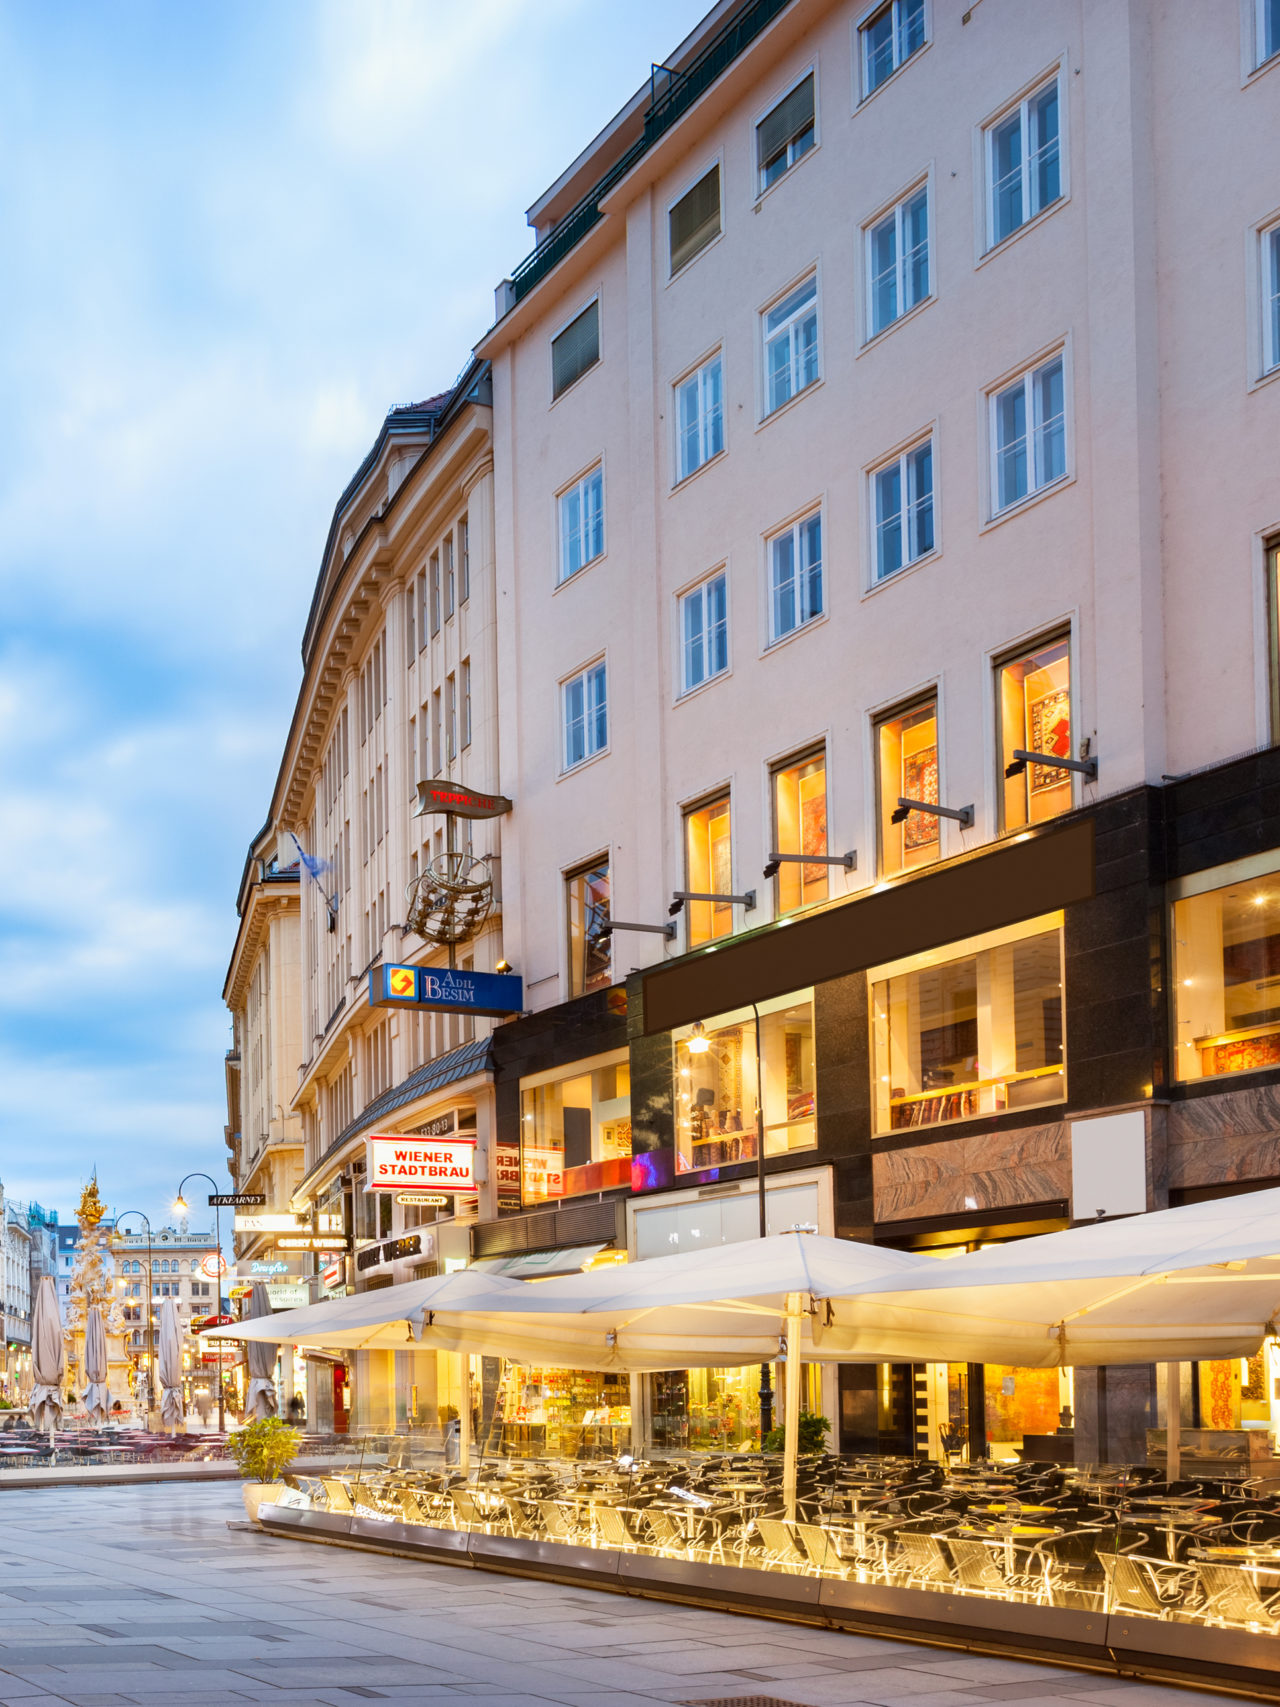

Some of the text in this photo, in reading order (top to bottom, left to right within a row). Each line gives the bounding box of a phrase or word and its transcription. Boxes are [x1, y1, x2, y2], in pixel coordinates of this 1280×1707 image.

[430, 790, 496, 810] TEPPICHE
[424, 975, 475, 1002] BESIM
[394, 1150, 454, 1163] WIENER
[379, 1163, 470, 1178] STADTBRÄU
[400, 1197, 444, 1205] RESTAURANT
[251, 1260, 290, 1275] Douglas
[1154, 1565, 1245, 1619] Café
